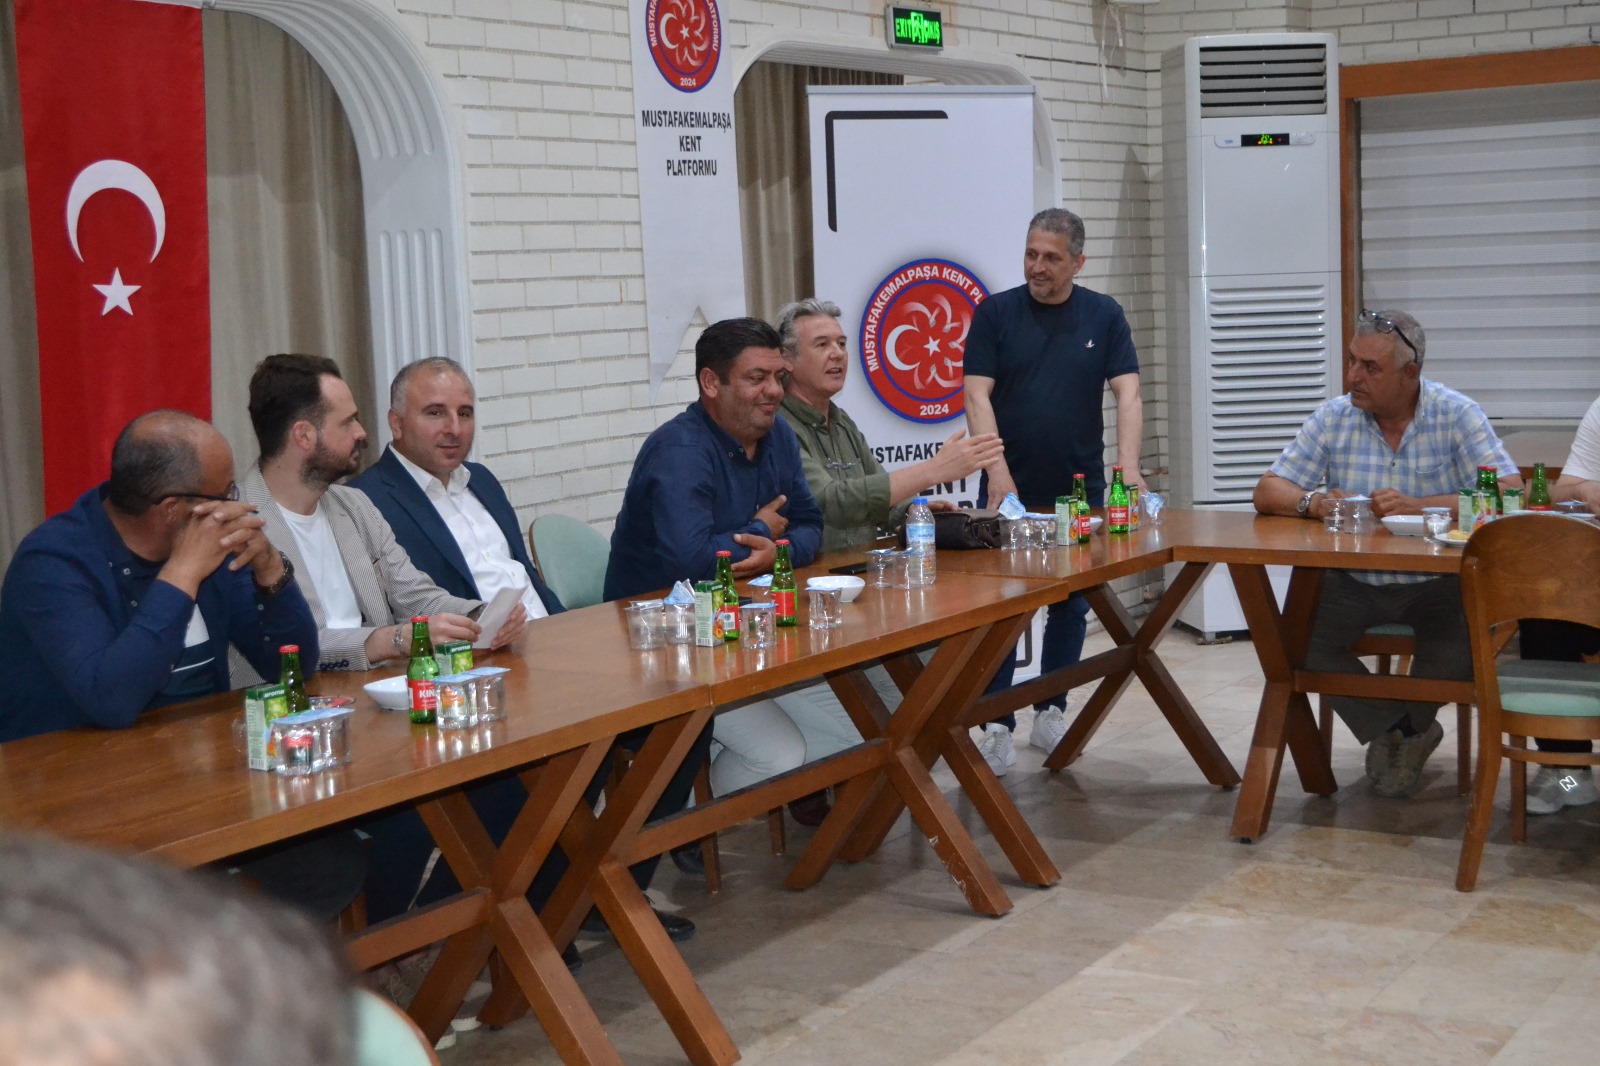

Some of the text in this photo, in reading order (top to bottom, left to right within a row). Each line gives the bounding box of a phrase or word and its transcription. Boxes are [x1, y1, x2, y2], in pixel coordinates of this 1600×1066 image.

[895, 18, 912, 38] EXIT
[680, 78, 697, 87] 2024
[642, 110, 732, 133] MUSTAFAKEMALPAŞA
[679, 135, 702, 152] KENT
[666, 159, 717, 176] PLATFORMU
[865, 265, 984, 372] MUSTAFAKEMALPAŞA KENT PL
[919, 403, 950, 416] 2024
[870, 441, 944, 464] STAFAK
[419, 688, 436, 698] KIN
